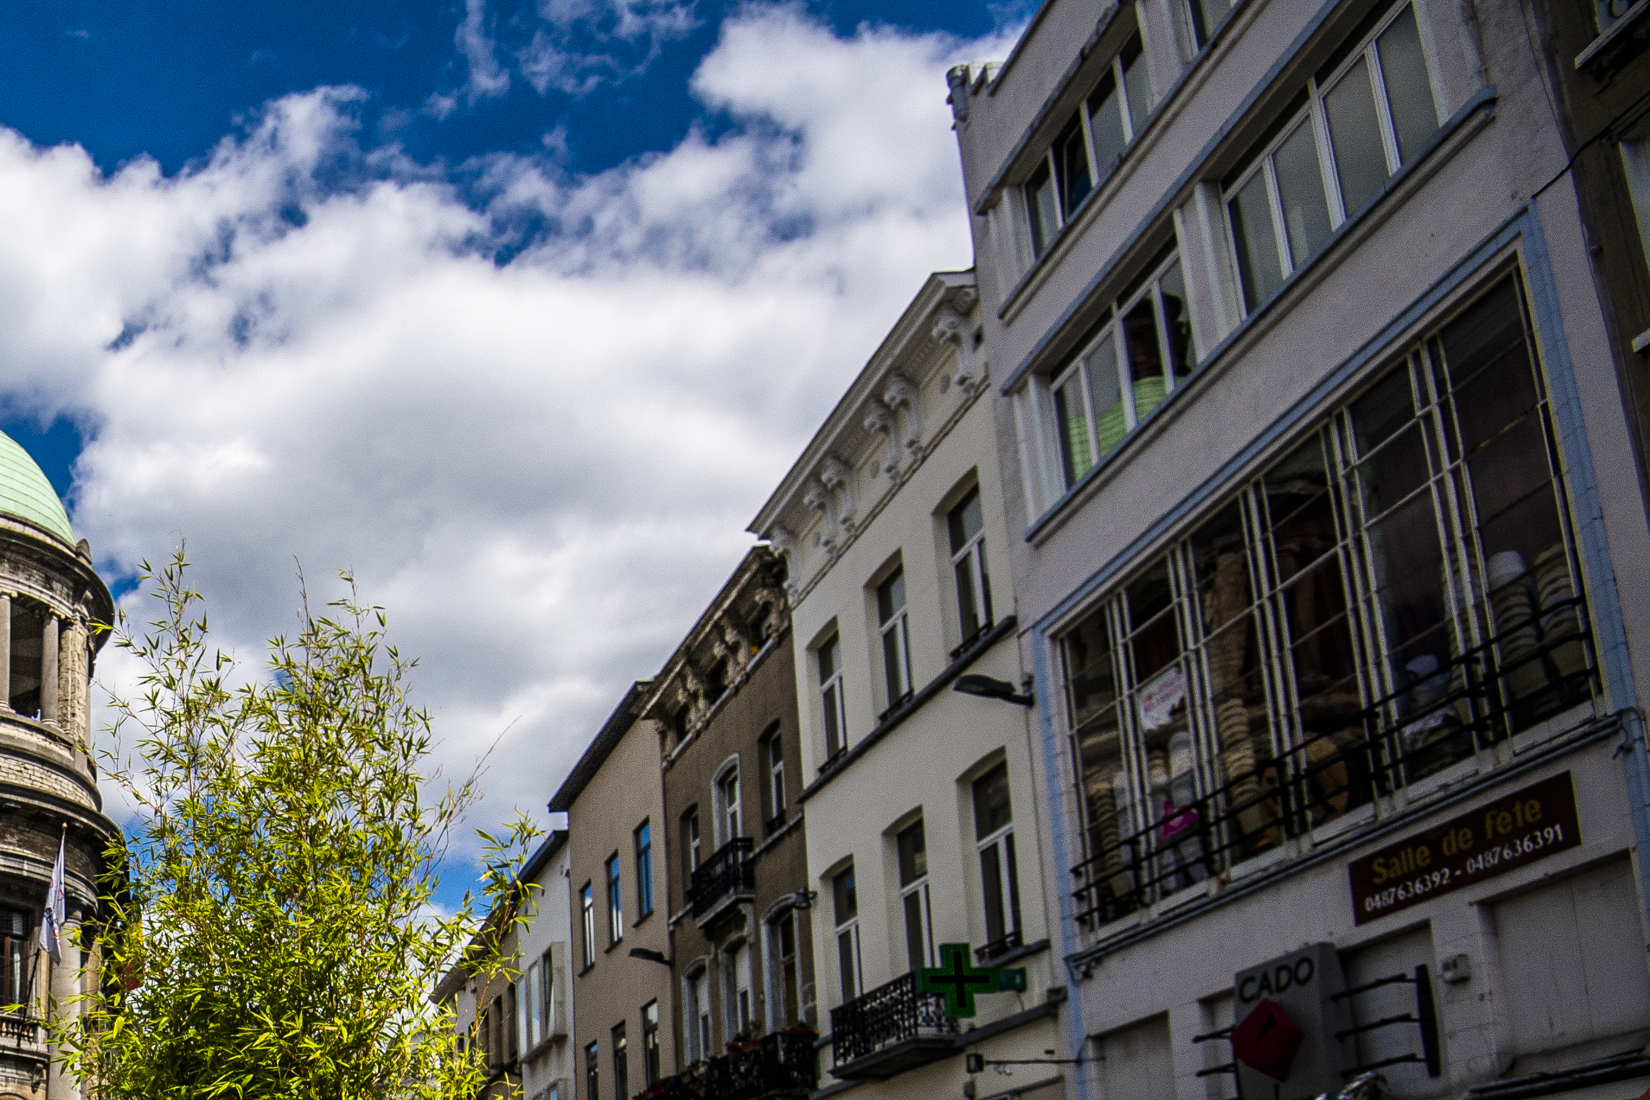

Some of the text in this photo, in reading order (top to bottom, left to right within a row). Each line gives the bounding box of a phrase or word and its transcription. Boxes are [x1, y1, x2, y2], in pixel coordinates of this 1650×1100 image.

[1363, 867, 1452, 913] 0487636392
[1465, 823, 1566, 876] 0487636391
[1371, 844, 1432, 886] Salle
[1441, 824, 1474, 858] de
[1238, 957, 1315, 1004] CADO
